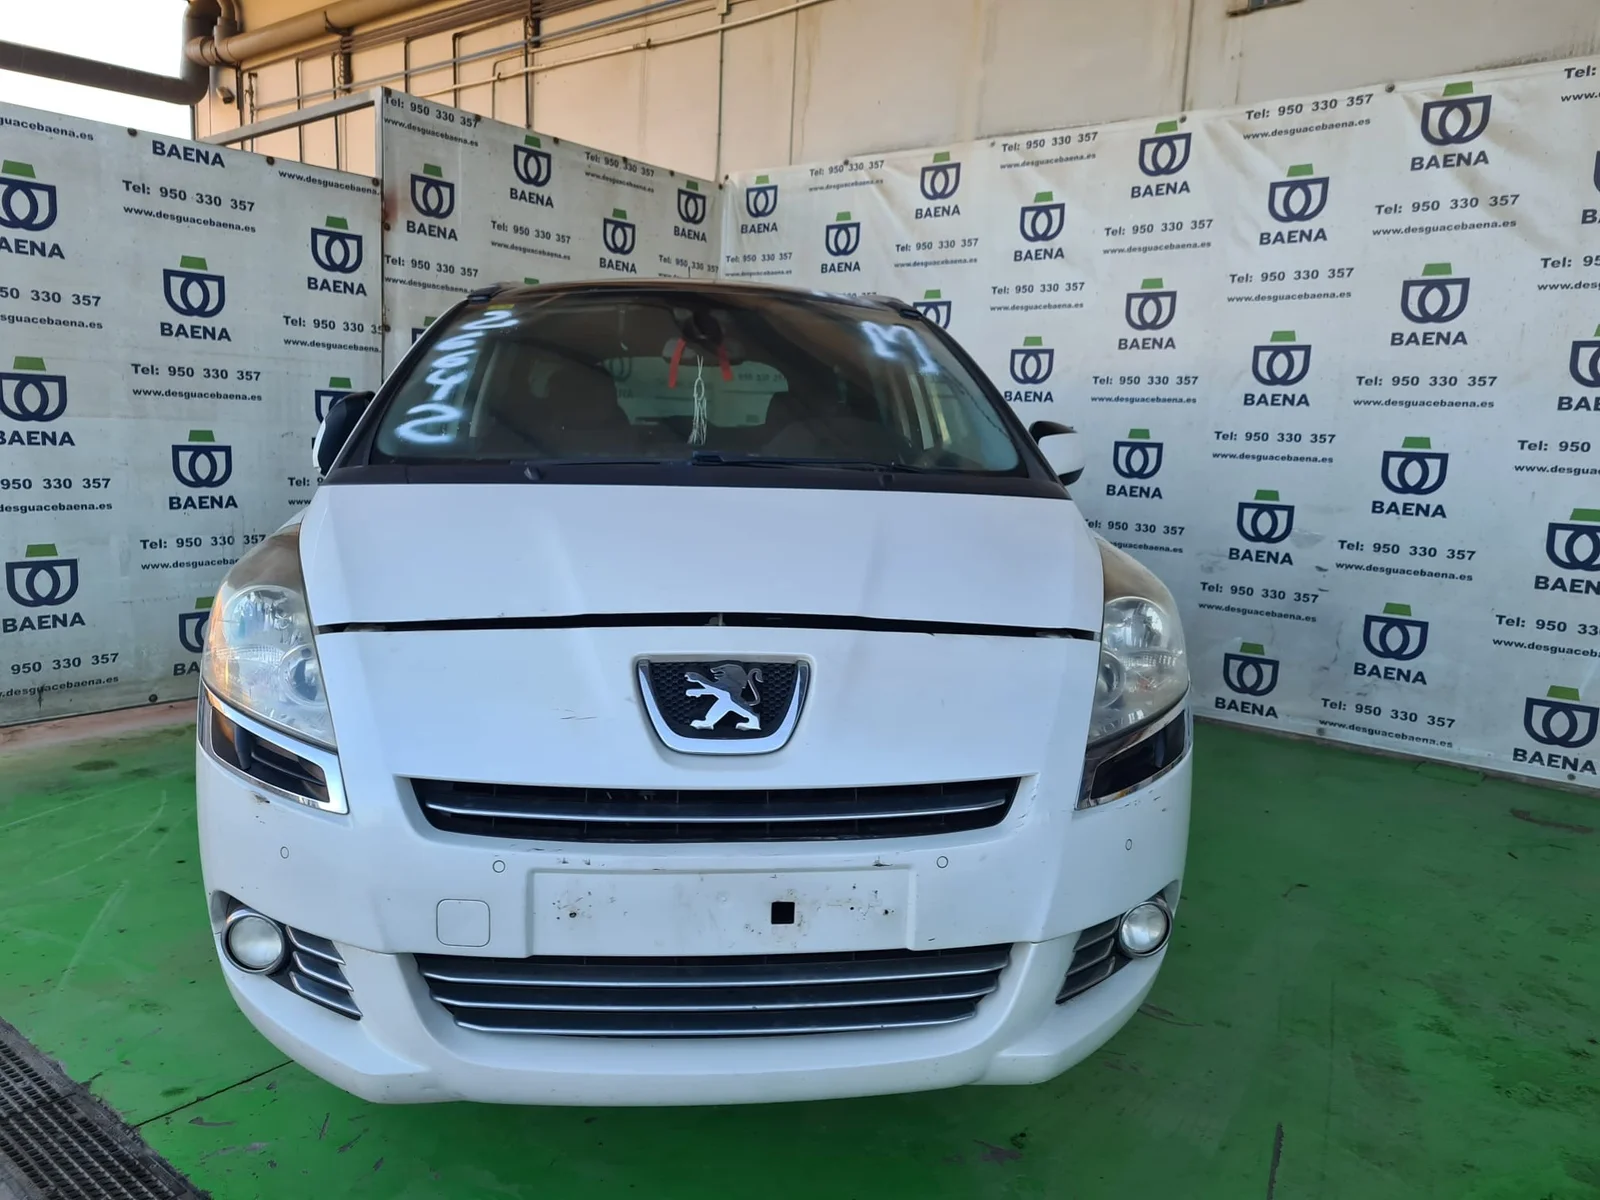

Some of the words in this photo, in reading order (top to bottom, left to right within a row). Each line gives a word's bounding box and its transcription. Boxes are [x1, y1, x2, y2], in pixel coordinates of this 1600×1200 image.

[1564, 65, 1596, 79] Tel:
[410, 102, 430, 116] 950
[436, 109, 454, 123] 330
[1246, 109, 1269, 120] Tel:
[1278, 104, 1303, 116] 950
[1312, 99, 1337, 111] 330
[1347, 94, 1373, 106] 357
[384, 116, 479, 148] www.desguacebaena.es
[1243, 118, 1371, 140] www.desguacebaena.es
[1002, 143, 1020, 152] Tel:
[1026, 139, 1045, 149] 950
[1052, 136, 1071, 146] 330
[1078, 132, 1098, 142] 357
[152, 140, 225, 168] BAENA
[1001, 154, 1095, 168] www.desguacebaena.es
[1411, 151, 1489, 171] BAENA
[585, 152, 600, 163] Tel:
[604, 156, 619, 168] 950
[623, 163, 638, 173] 330
[641, 167, 654, 177] 357
[828, 164, 844, 174] 950
[848, 162, 864, 172] 330
[869, 160, 884, 169] 357
[122, 180, 150, 195] Tel:
[160, 187, 187, 201] 950
[196, 193, 221, 207] 330
[231, 199, 254, 212] 357
[510, 188, 554, 208] BAENA
[1131, 181, 1190, 198] BAENA
[915, 205, 960, 219] BAENA
[1375, 204, 1402, 215] Tel:
[1412, 201, 1440, 212] 950
[1450, 197, 1479, 209] 330
[1489, 194, 1519, 207] 357
[124, 206, 256, 232] www.desguacebaena.es
[1105, 227, 1125, 236] Tel:
[1132, 224, 1153, 234] 950
[1161, 222, 1183, 232] 330
[1191, 219, 1213, 229] 357
[1372, 218, 1517, 236] www.desguacebaena.es
[407, 220, 458, 241] BAENA
[491, 220, 507, 232] Tel:
[513, 225, 529, 236] 950
[535, 229, 551, 240] 330
[556, 233, 570, 243] 357
[674, 226, 707, 243] BAENA
[741, 222, 778, 234] BAENA
[1259, 228, 1327, 245] BAENA
[896, 244, 910, 252] Tel:
[916, 242, 932, 250] 950
[939, 240, 955, 249] 330
[961, 238, 978, 247] 357
[1104, 242, 1211, 253] www.desguacebaena.es
[780, 252, 792, 260] 357
[1014, 248, 1064, 262] BAENA
[1541, 257, 1571, 268] Tel:
[384, 254, 404, 266] Tel:
[411, 259, 430, 270] 950
[437, 263, 454, 274] 330
[461, 267, 478, 277] 357
[600, 257, 636, 273] BAENA
[821, 261, 860, 273] BAENA
[1230, 273, 1252, 283] Tel:
[1261, 272, 1285, 282] 950
[1294, 270, 1319, 280] 330
[1328, 268, 1354, 278] 357
[307, 276, 367, 296] BAENA
[992, 286, 1009, 294] Tel:
[1015, 285, 1034, 293] 950
[1040, 283, 1059, 292] 330
[1066, 282, 1085, 291] 357
[31, 290, 61, 303] 330
[72, 294, 101, 306] 357
[1228, 292, 1351, 302] www.desguacebaena.es
[991, 303, 1083, 311] www.desguacebaena.es
[160, 322, 231, 342] BAENA
[283, 315, 305, 327] Tel:
[313, 319, 335, 330] 950
[343, 321, 364, 333] 330
[1118, 337, 1175, 350] BAENA
[1391, 331, 1468, 346] BAENA
[131, 363, 159, 375] Tel:
[168, 366, 194, 377] 950
[203, 368, 228, 379] 330
[237, 370, 261, 381] 357
[1093, 376, 1112, 384] Tel:
[1120, 376, 1140, 385] 950
[1148, 376, 1169, 385] 330
[1176, 376, 1198, 385] 357
[1356, 376, 1382, 386] Tel:
[1392, 376, 1419, 386] 950
[1429, 376, 1457, 386] 330
[1468, 376, 1497, 386] 357
[132, 388, 262, 402] www.desguacebaena.es
[1004, 391, 1054, 404] BAENA
[1091, 396, 1196, 404] www.desguacebaena.es
[1244, 393, 1310, 407] BAENA
[1353, 398, 1495, 410] www.desguacebaena.es
[1214, 431, 1237, 440] Tel:
[1245, 432, 1269, 441] 950
[1277, 433, 1302, 443] 330
[1310, 434, 1336, 443] 357
[1518, 440, 1548, 451] Tel:
[1559, 441, 1591, 452] 950
[1213, 453, 1333, 463] www.desguacebaena.es
[0, 478, 32, 490] 950
[43, 478, 72, 489] 330
[82, 478, 111, 489] 357
[1106, 484, 1162, 499] BAENA
[169, 495, 238, 510] BAENA
[1371, 501, 1447, 518] BAENA
[1108, 521, 1128, 531] 950
[1135, 523, 1156, 533] 330
[1163, 525, 1185, 535] 357
[140, 538, 167, 549] Tel:
[176, 537, 202, 548] 950
[211, 535, 235, 546] 330
[1338, 540, 1364, 551] Tel:
[1373, 543, 1400, 554] 950
[1409, 546, 1437, 557] 330
[1446, 549, 1476, 560] 357
[1228, 548, 1293, 565] BAENA
[1336, 562, 1473, 580] www.desguacebaena.es
[1200, 582, 1223, 593] Tel:
[1230, 585, 1254, 596] 950
[1261, 589, 1286, 600] 330
[1294, 592, 1319, 603] 357
[1199, 604, 1316, 622] www.desguacebaena.es
[2, 612, 86, 633] BAENA
[1496, 615, 1525, 627] Tel:
[1536, 619, 1567, 632] 950
[11, 662, 42, 674] 950
[52, 657, 81, 670] 330
[91, 653, 119, 665] 357
[1354, 662, 1427, 685] BAENA
[1215, 697, 1278, 719] BAENA
[1321, 698, 1346, 710] Tel:
[1355, 704, 1381, 716] 950
[1390, 709, 1418, 722] 330
[1427, 715, 1455, 728] 357
[1320, 719, 1453, 747] www.desguacebaena.es
[1513, 748, 1597, 775] BAENA
